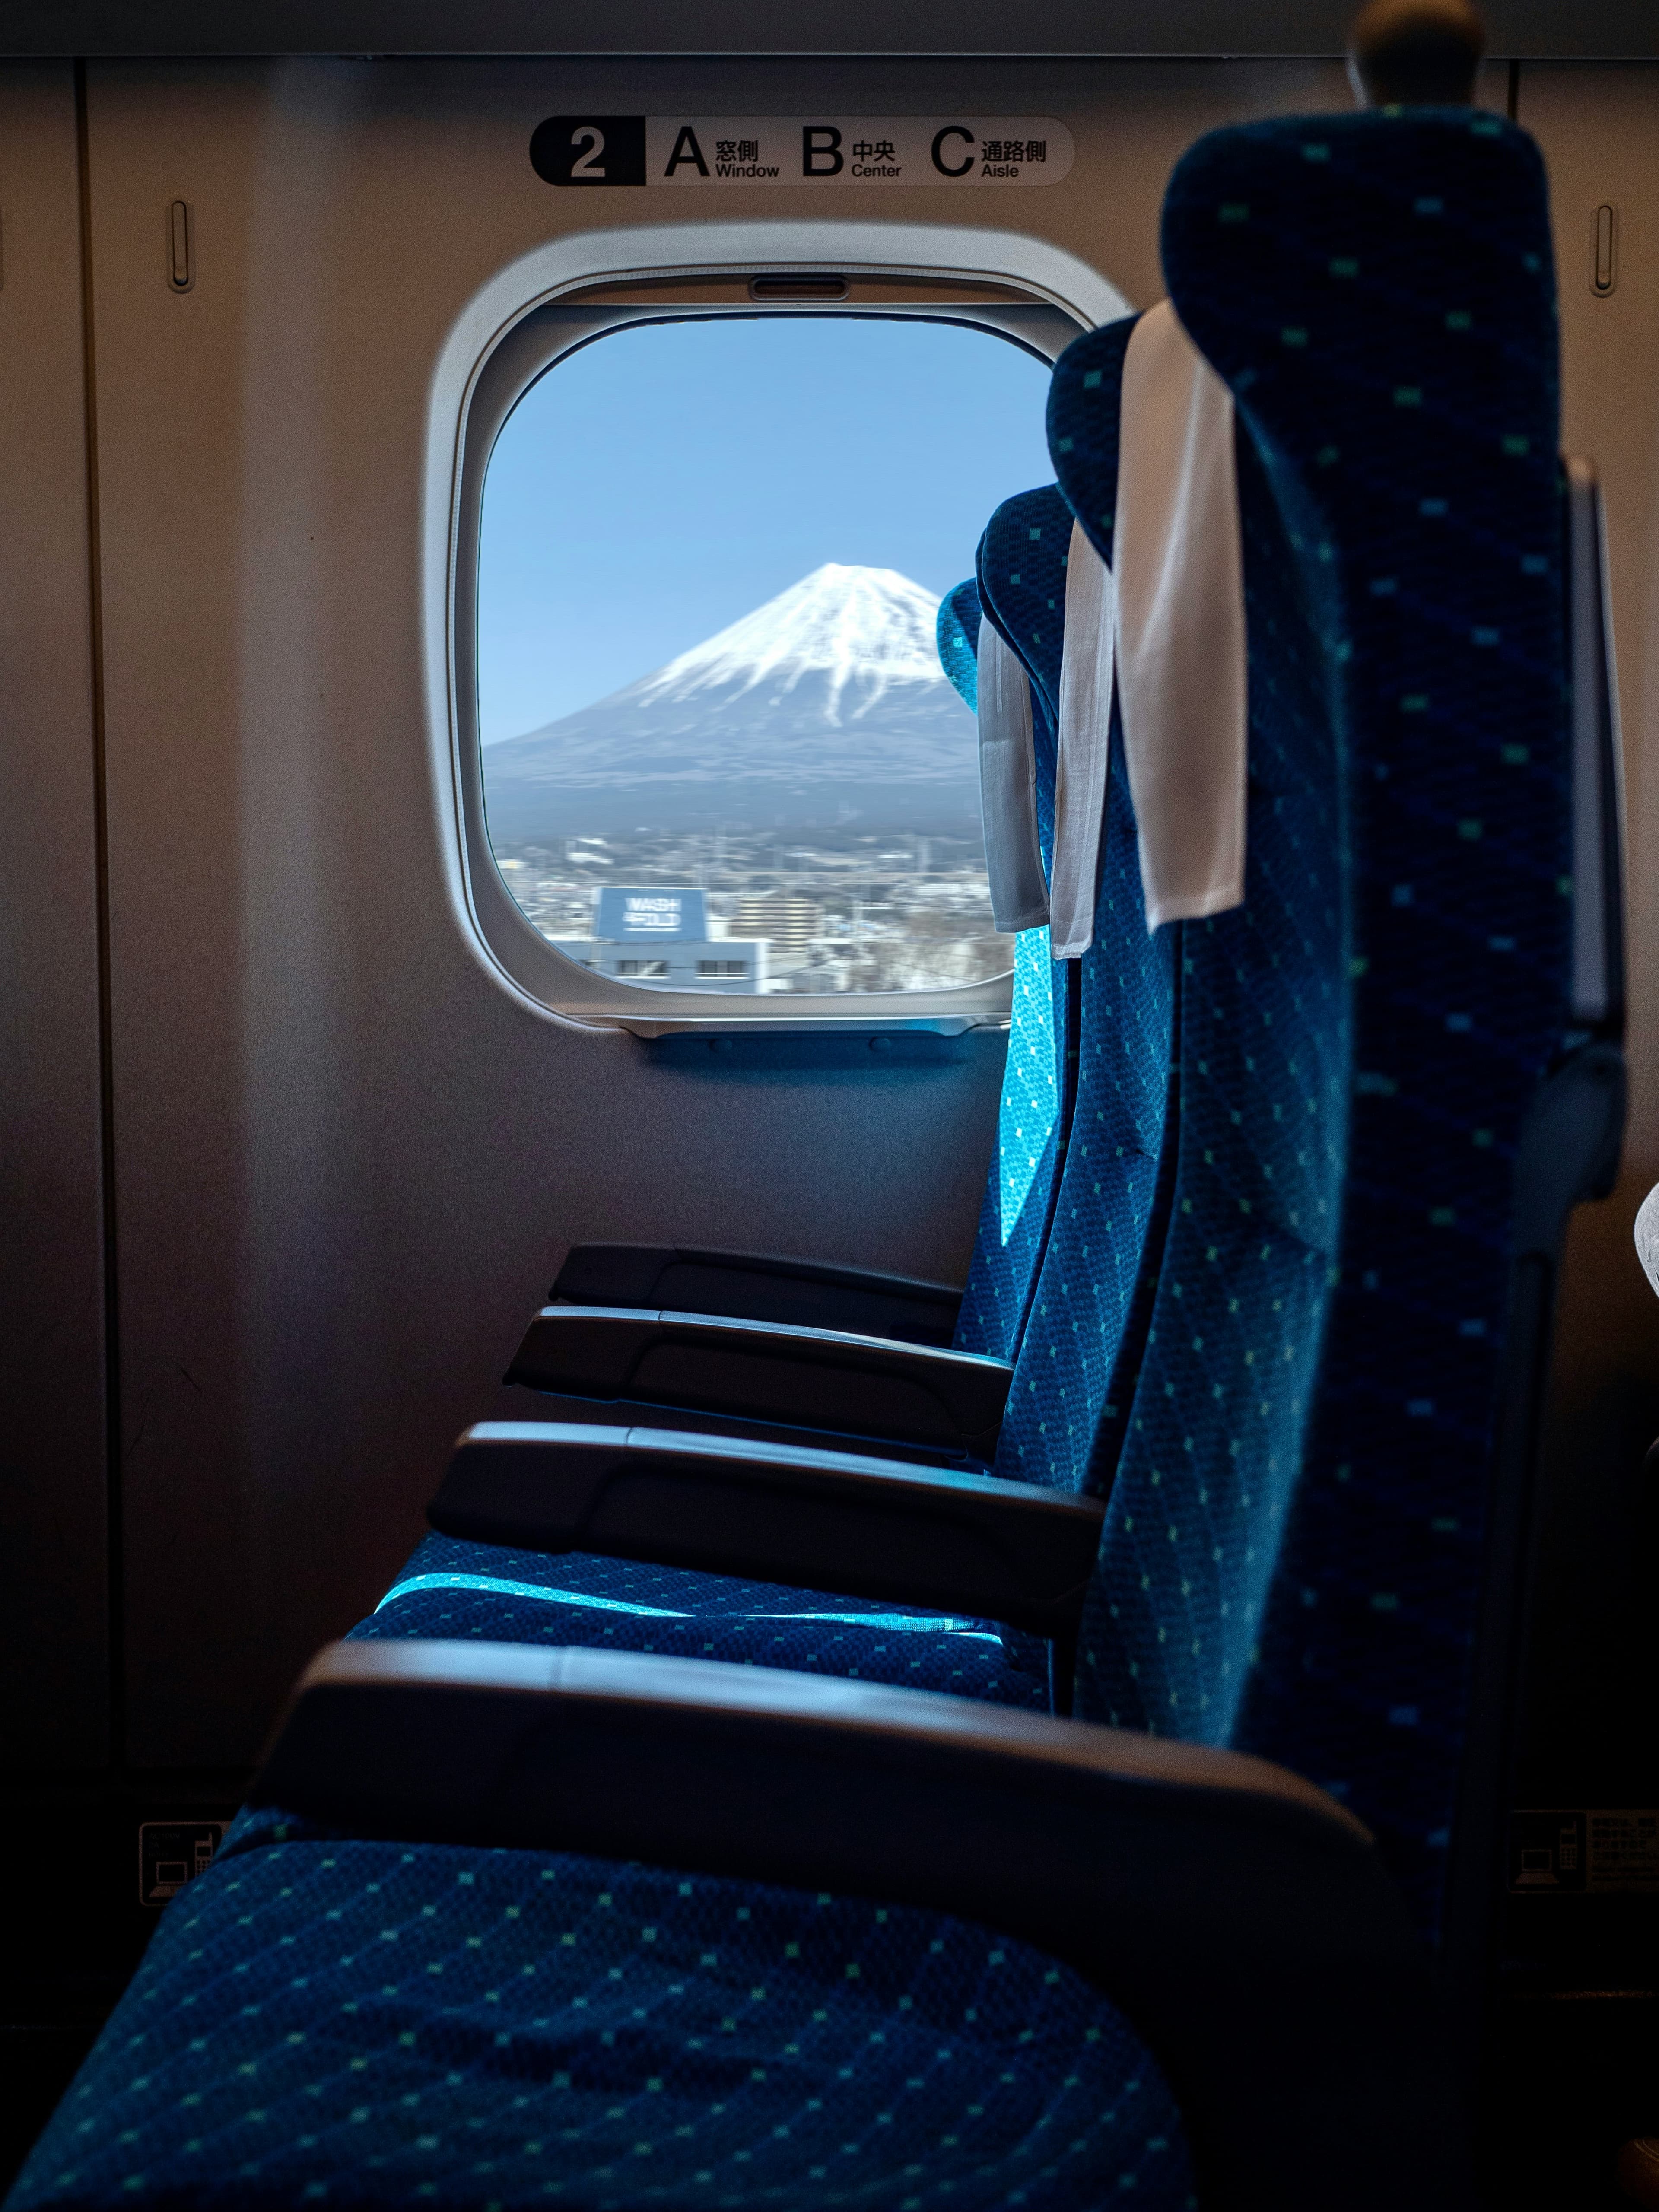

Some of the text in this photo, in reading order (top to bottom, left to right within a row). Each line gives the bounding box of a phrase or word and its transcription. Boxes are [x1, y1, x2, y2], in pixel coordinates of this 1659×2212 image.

[571, 126, 605, 177] 2
[664, 126, 710, 177] A
[715, 140, 759, 162] 窓側
[802, 125, 844, 177] B
[852, 140, 896, 162] 中央
[931, 125, 975, 177] C
[981, 140, 1047, 162] 通路側
[715, 164, 779, 177] Window
[851, 164, 902, 177] Center
[981, 164, 1019, 178] Aisle
